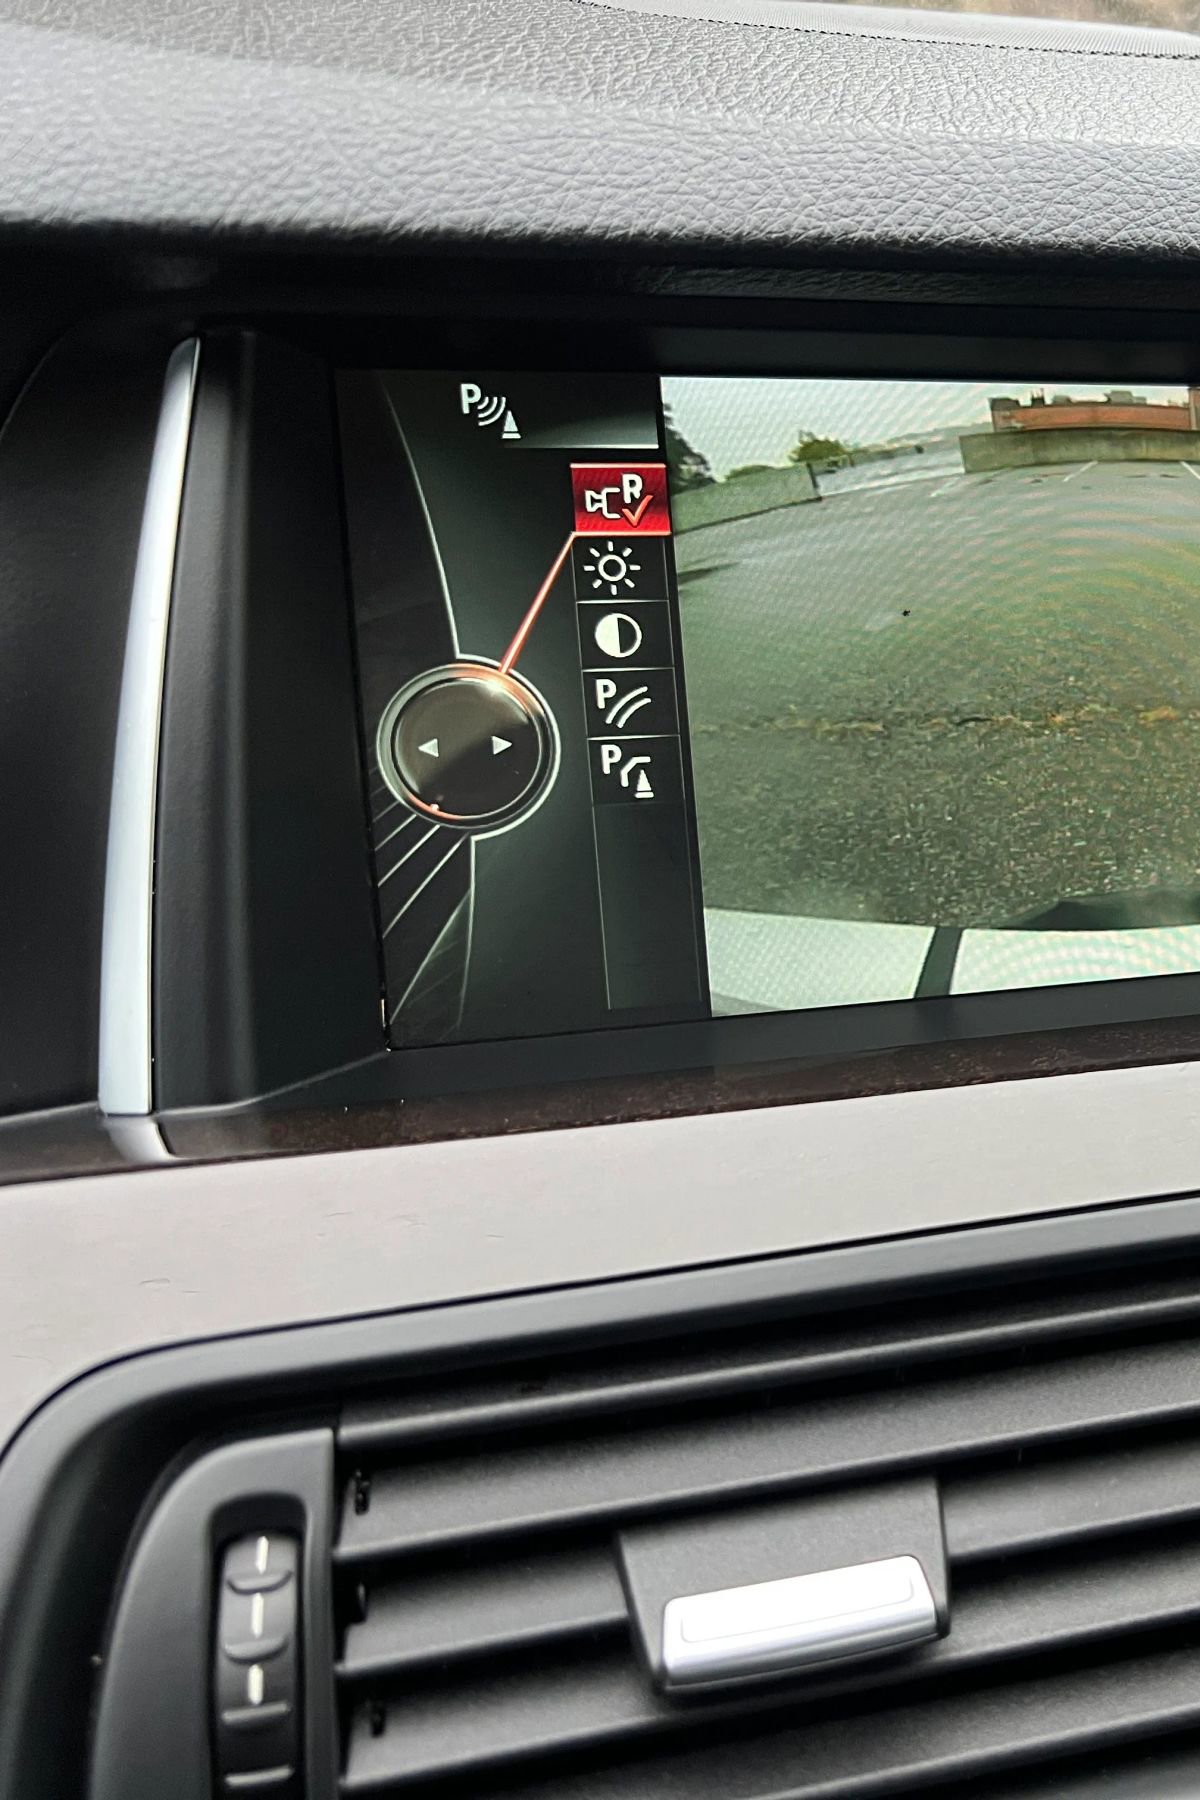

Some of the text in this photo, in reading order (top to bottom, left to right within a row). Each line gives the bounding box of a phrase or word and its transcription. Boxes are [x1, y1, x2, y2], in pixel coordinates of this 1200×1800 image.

[460, 383, 482, 415] P
[595, 678, 617, 709] P
[601, 744, 622, 775] P
